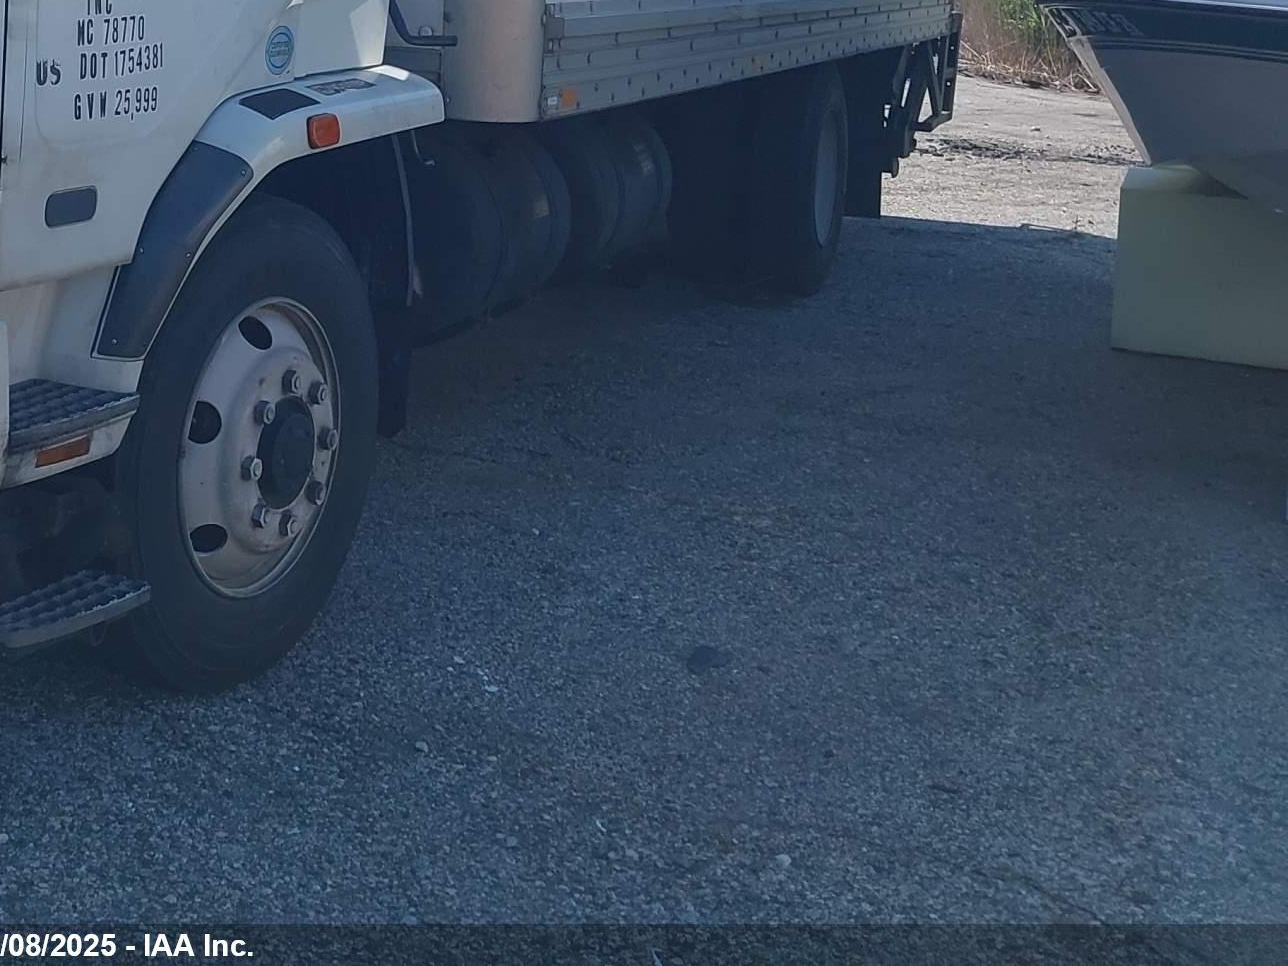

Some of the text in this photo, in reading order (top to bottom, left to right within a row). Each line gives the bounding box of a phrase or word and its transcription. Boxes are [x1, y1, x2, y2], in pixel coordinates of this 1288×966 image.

[78, 15, 144, 46] MC 78770
[36, 42, 163, 86] US DOT 1754381
[114, 87, 157, 120] 25,999
